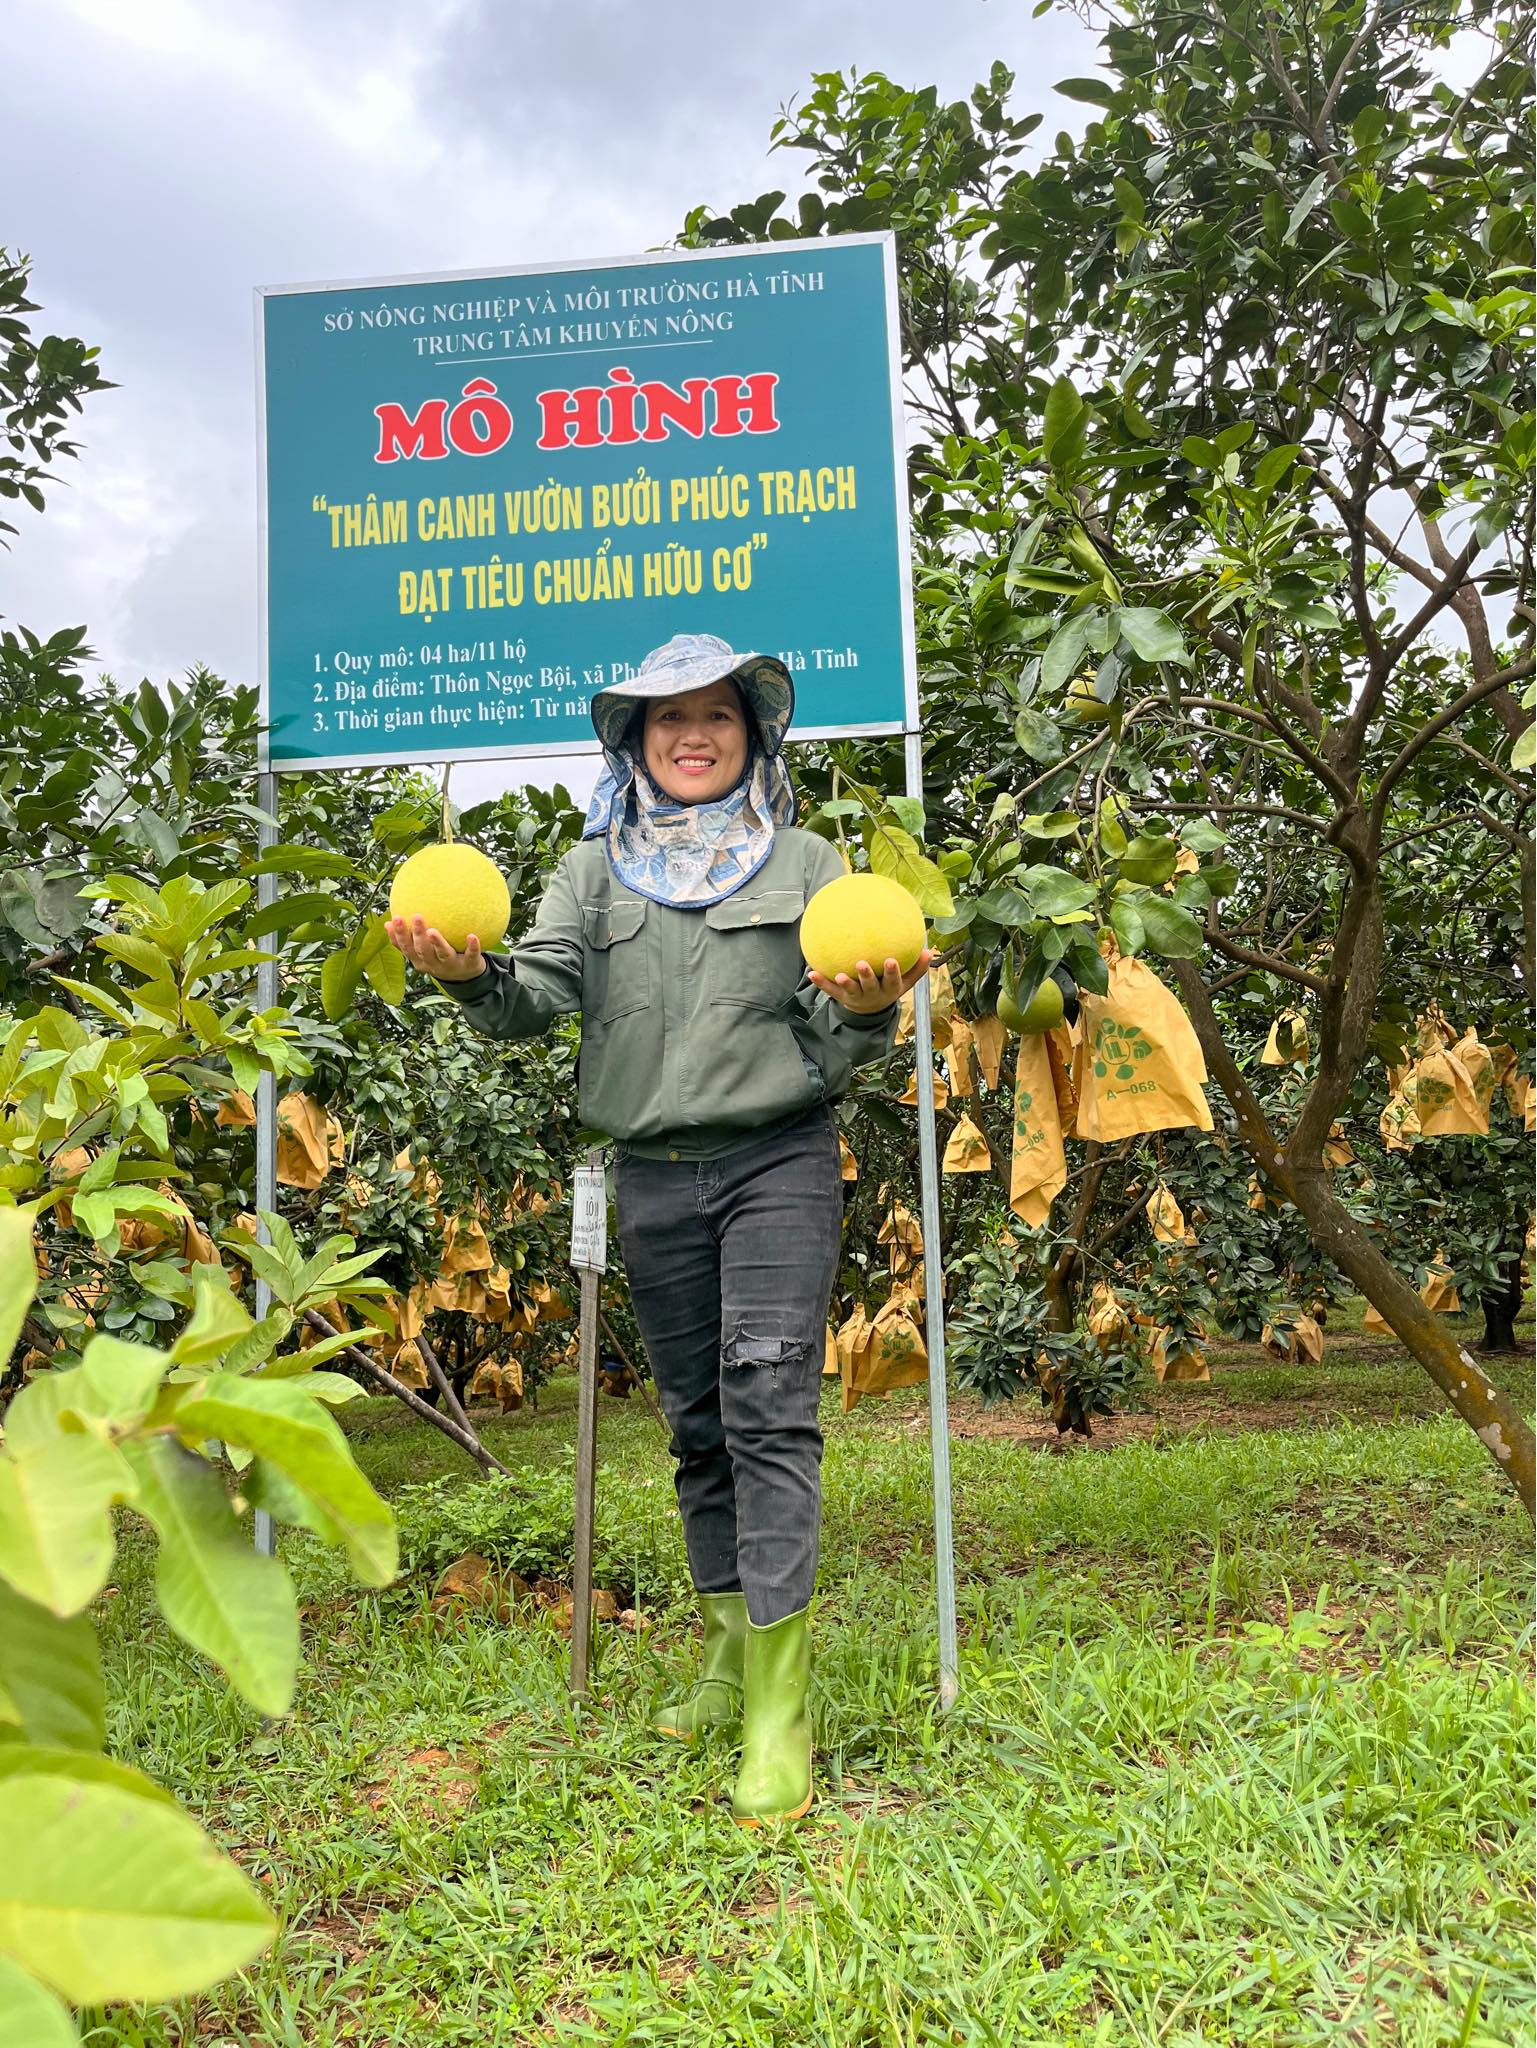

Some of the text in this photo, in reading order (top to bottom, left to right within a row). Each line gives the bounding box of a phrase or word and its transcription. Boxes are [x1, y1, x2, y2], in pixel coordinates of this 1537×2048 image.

[323, 270, 825, 333] SỞ NÔNG NGHIỆP VÀ MÔI TRƯỜNG HÀ TĨNH
[413, 331, 495, 356] TRUNG
[500, 322, 552, 349] TÂM
[665, 308, 734, 335] NÔNG
[374, 366, 782, 464] MÔ HÌNH
[418, 493, 497, 541] CANH
[504, 478, 584, 533] VƯỜN
[592, 466, 661, 530] BƯỞI
[670, 465, 749, 520] PHÚC
[759, 464, 857, 524] TRẠCH
[397, 567, 454, 624] ĐẠT
[462, 555, 524, 609] TIÊU
[534, 537, 634, 604] CHUẨN
[643, 544, 704, 596] HỮU
[312, 682, 329, 703] 2.
[334, 681, 367, 706] Địa
[372, 671, 425, 699] điểm:
[430, 672, 480, 695] Thôn
[486, 670, 535, 696] Ngọc
[540, 665, 578, 690] Bội,
[583, 664, 606, 685] xã
[778, 648, 807, 672] Hà
[811, 647, 859, 669] Tĩnh
[313, 638, 528, 675] 1. Quy mô: 04 ha/11 hộ
[312, 694, 592, 733] 3. Thời gian thực hiện: Từ nă
